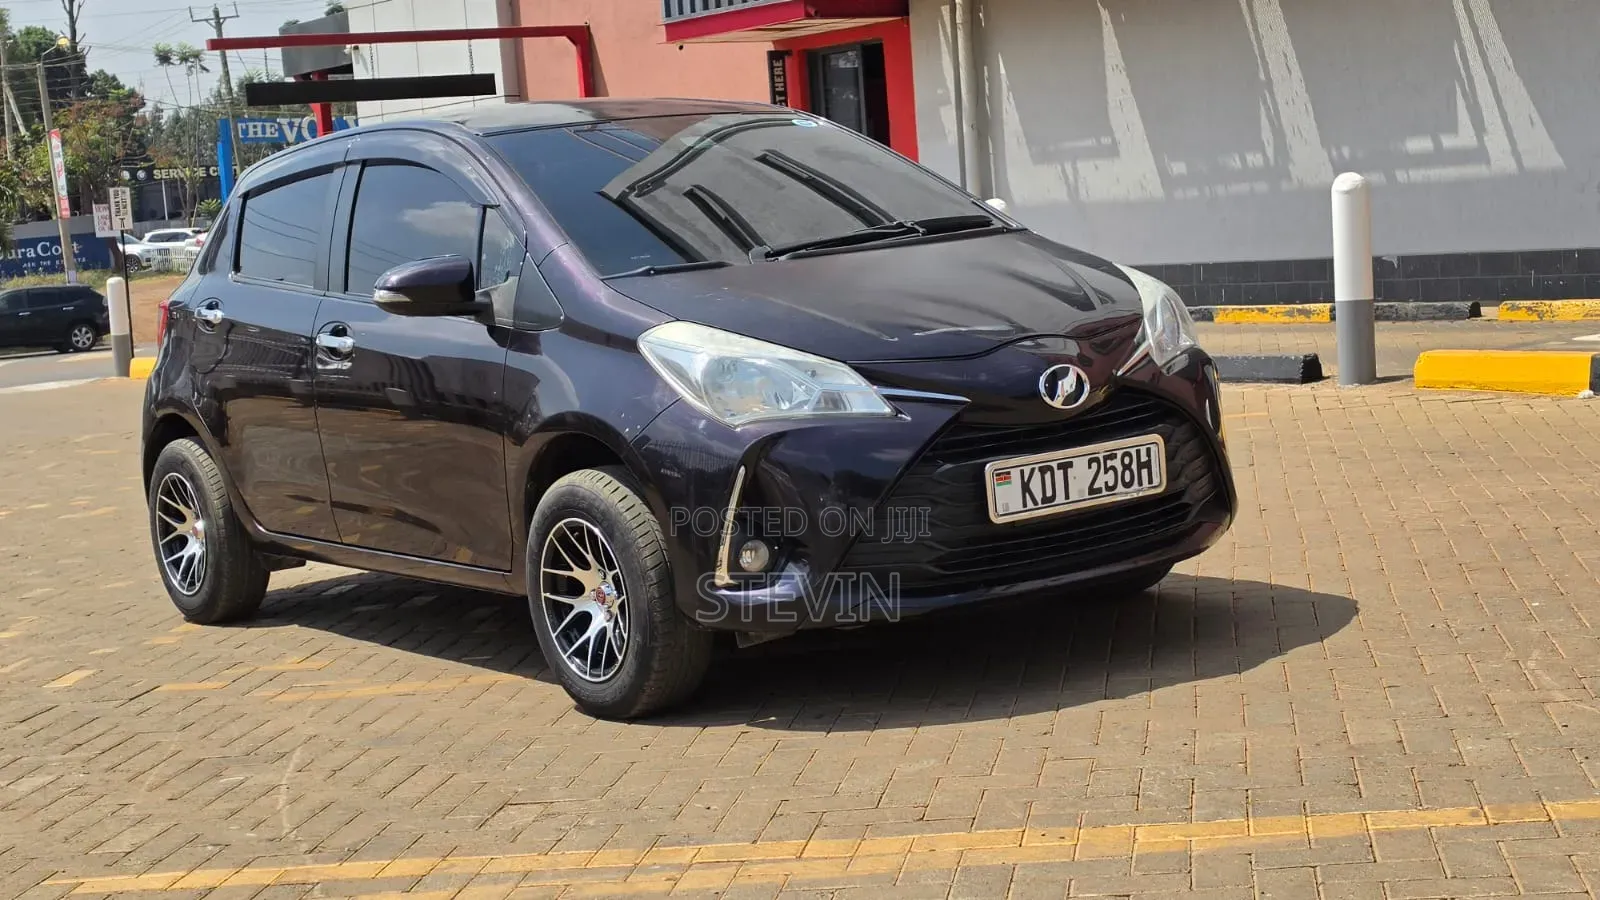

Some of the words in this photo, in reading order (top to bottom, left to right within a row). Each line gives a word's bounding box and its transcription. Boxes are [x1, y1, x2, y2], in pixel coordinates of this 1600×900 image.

[772, 59, 785, 91] HERE
[237, 121, 279, 138] THE
[1019, 460, 1074, 509] KDT
[1087, 446, 1154, 496] 258H
